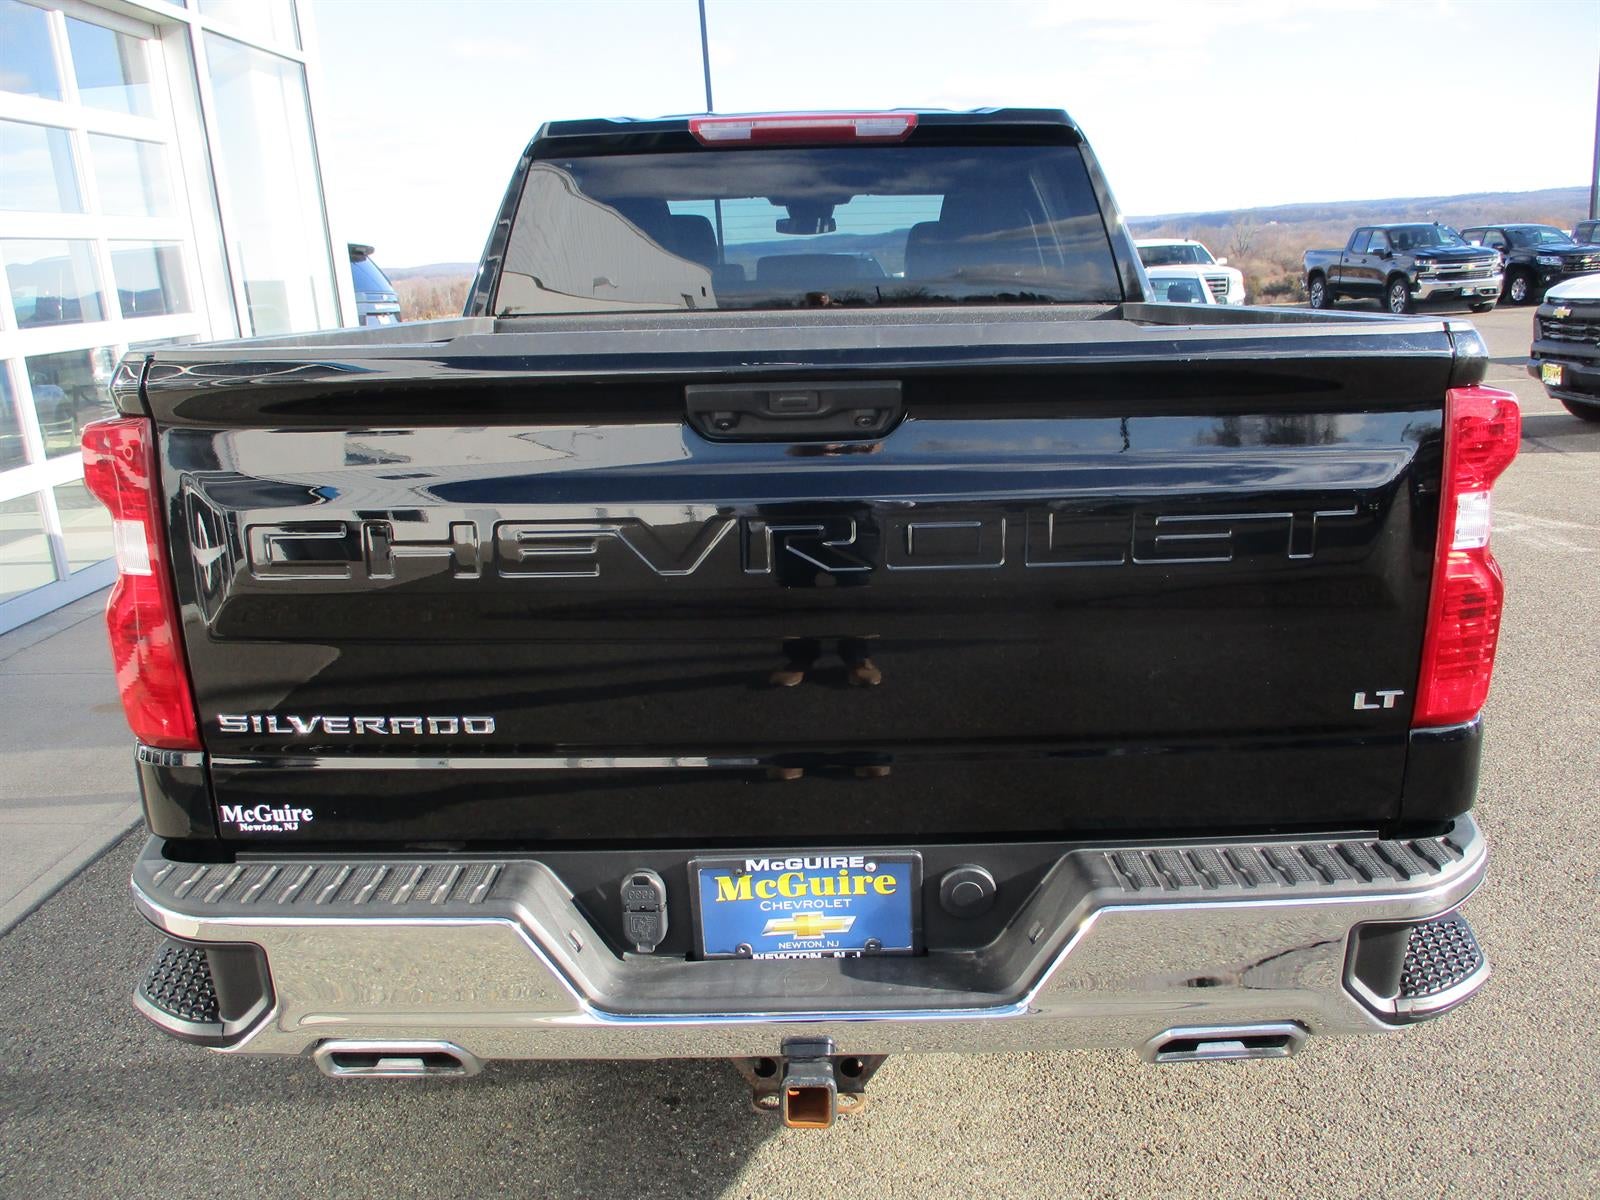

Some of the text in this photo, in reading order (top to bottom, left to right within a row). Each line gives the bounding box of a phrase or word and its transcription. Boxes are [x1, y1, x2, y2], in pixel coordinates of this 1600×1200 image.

[244, 500, 1360, 582] CHEVROLET
[1353, 689, 1405, 710] LT
[216, 713, 497, 736] SILVERADO
[220, 803, 314, 823] McGuire
[239, 822, 299, 832] Newton, NJ
[745, 855, 865, 872] McGUIRE
[714, 870, 897, 902] McGuire
[759, 898, 853, 912] CHEVROLET
[778, 940, 840, 949] NEWTON, NJ
